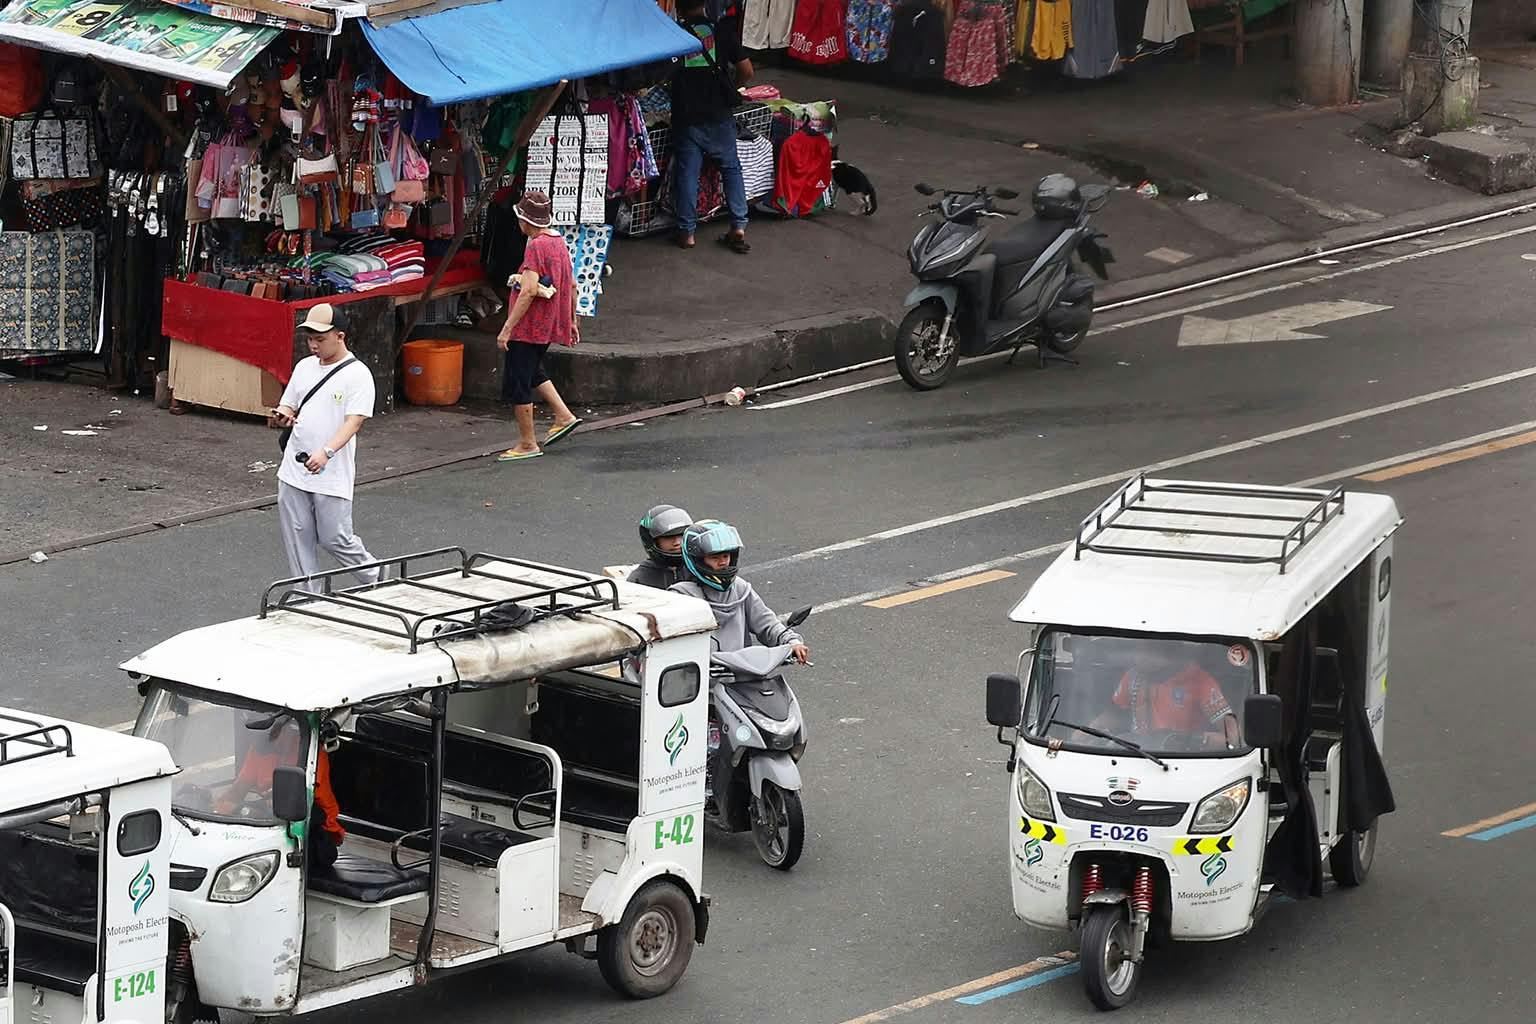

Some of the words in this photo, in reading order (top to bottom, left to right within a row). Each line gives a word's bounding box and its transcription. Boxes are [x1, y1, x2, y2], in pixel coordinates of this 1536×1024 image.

[188, 22, 226, 34] FORTUNE
[560, 136, 581, 146] CITY
[555, 211, 577, 222] CITY
[647, 769, 683, 788] Motoposh
[684, 764, 706, 778] Electr
[655, 815, 695, 849] E-42
[1090, 824, 1149, 842] E-026
[1177, 889, 1218, 900] Motoposh
[1219, 882, 1245, 896] Electric
[106, 921, 144, 937] Motoposh
[146, 915, 168, 928] Electr
[114, 970, 155, 1002] E-124
